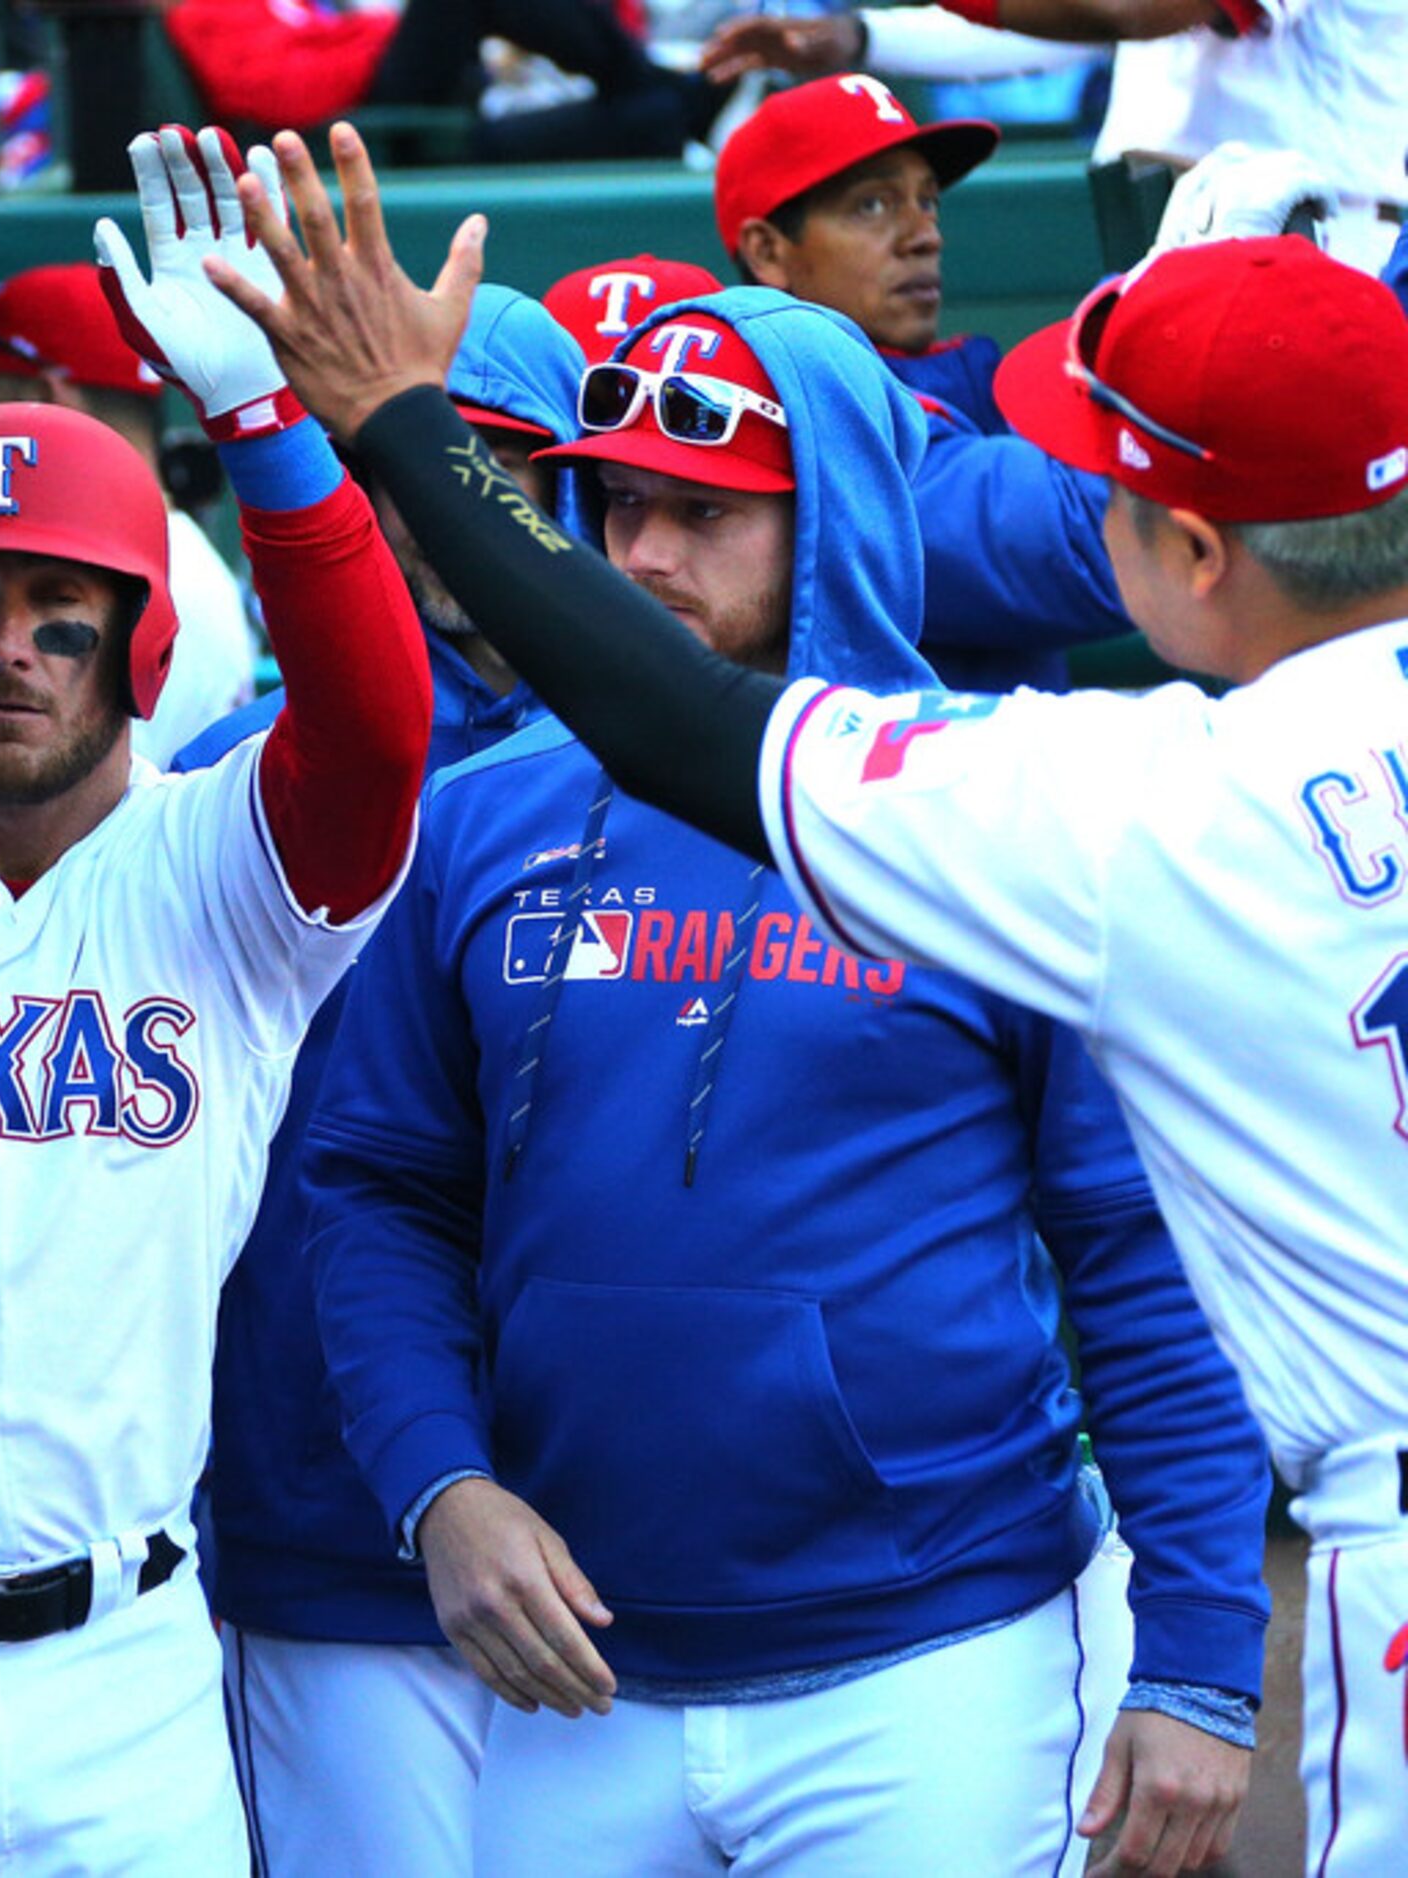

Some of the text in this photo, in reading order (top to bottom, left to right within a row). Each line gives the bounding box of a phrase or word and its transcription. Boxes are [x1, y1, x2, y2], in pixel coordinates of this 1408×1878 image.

[838, 73, 905, 125] T
[588, 271, 657, 337] T
[1292, 740, 1408, 910] C
[514, 886, 657, 909] TEAS
